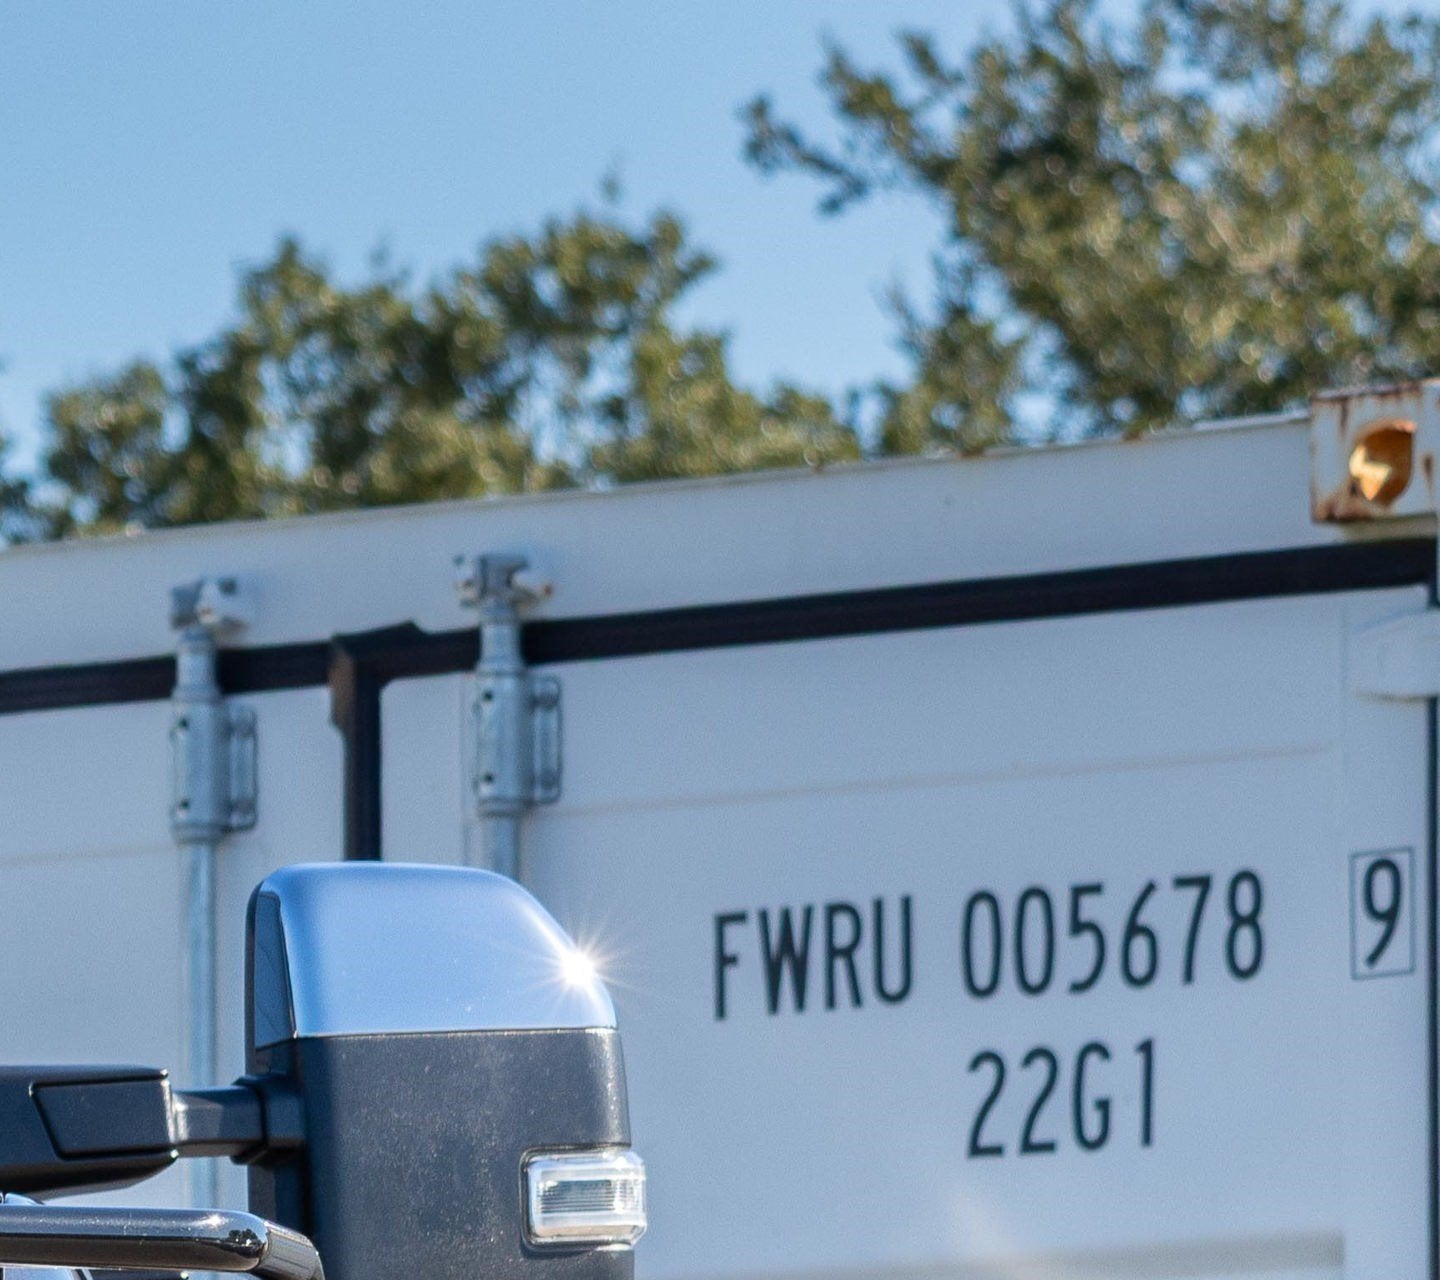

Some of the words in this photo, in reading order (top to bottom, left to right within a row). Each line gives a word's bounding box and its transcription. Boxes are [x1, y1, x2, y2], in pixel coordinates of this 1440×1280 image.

[715, 895, 913, 1020] FWRU
[961, 869, 1264, 999] 005678
[1363, 857, 1403, 967] 9
[968, 1038, 1155, 1158] 22G1
